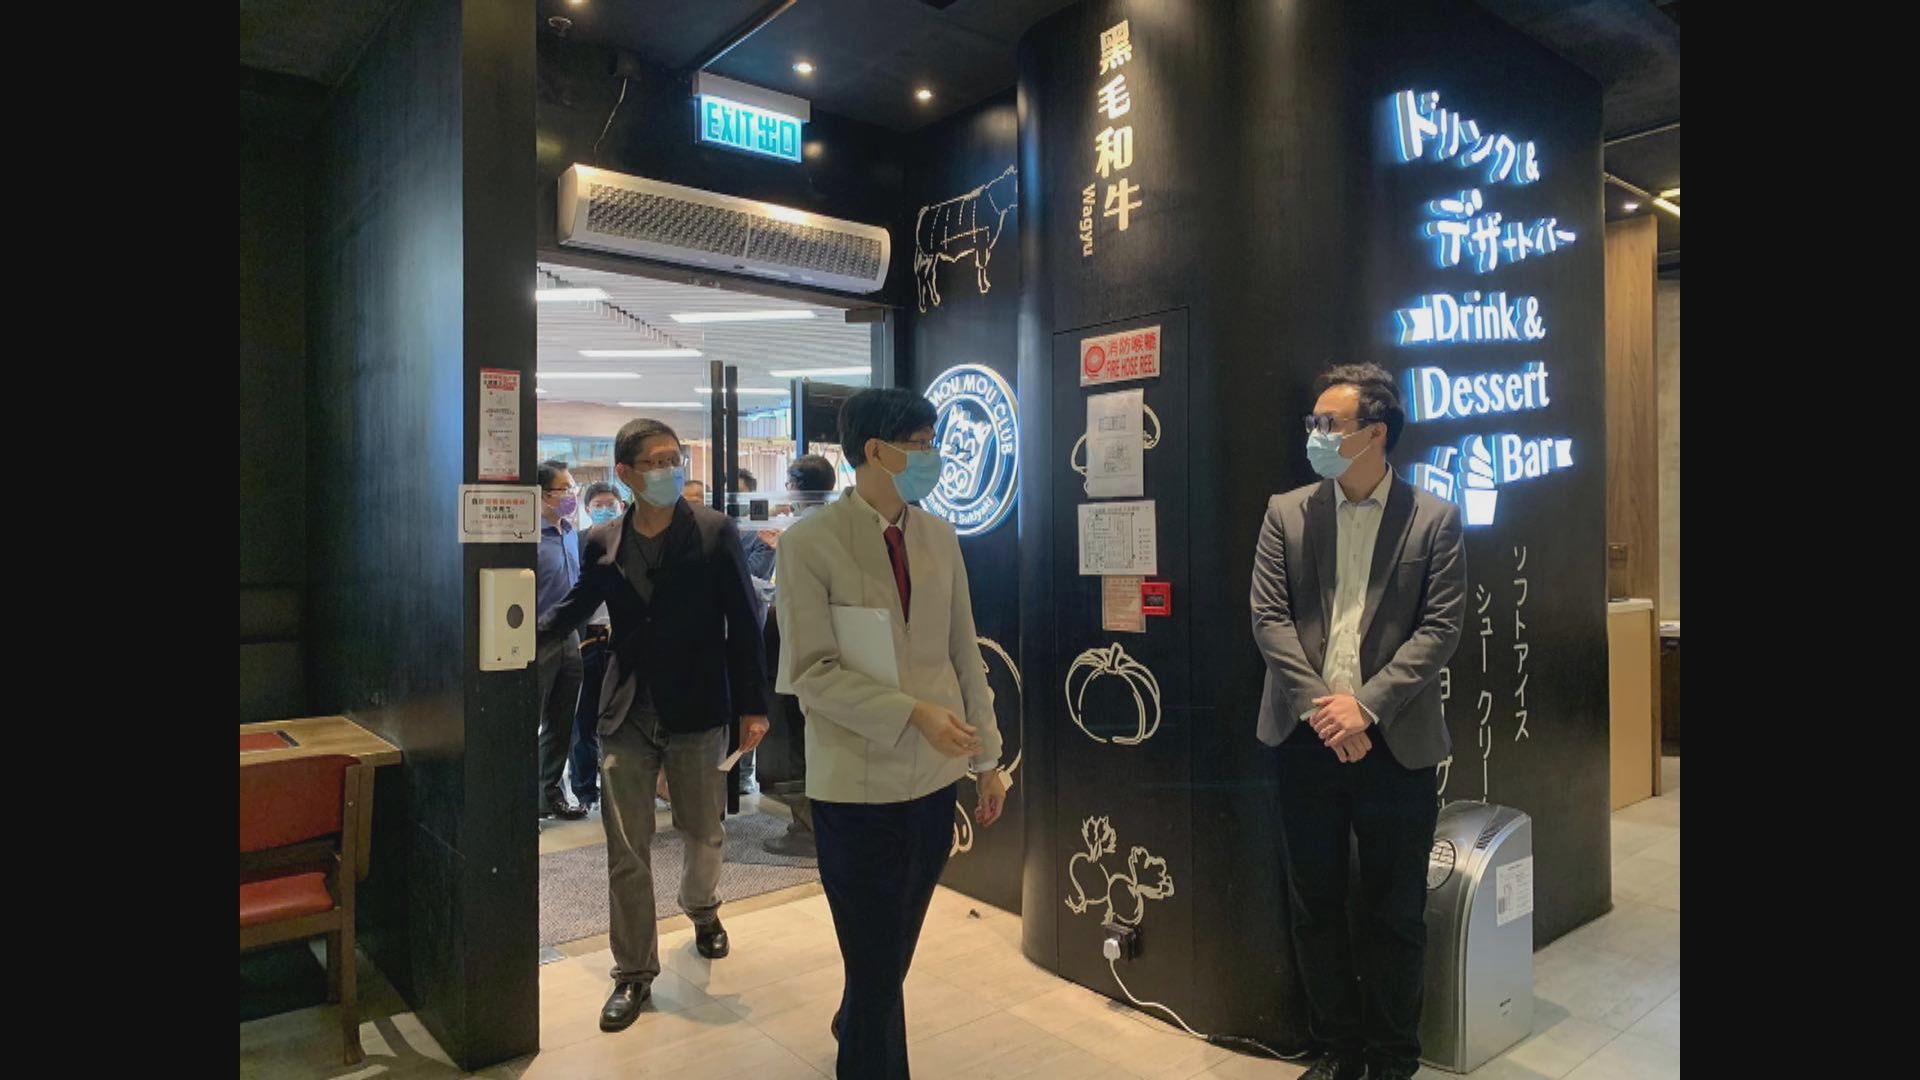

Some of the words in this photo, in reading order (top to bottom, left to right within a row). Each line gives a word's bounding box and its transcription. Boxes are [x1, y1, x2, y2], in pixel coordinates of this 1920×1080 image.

[706, 102, 753, 147] EXIT
[757, 114, 797, 157] 出口
[1095, 19, 1142, 232] 黑毛和牛
[1403, 90, 1516, 181] ドリンク
[1522, 141, 1540, 182] &
[1080, 183, 1096, 257] Wagyu
[1431, 290, 1518, 342] Drink
[1522, 295, 1546, 340] &
[1106, 359, 1120, 378] FIRE
[1121, 356, 1138, 377] HOSE
[1140, 353, 1156, 375] REEL
[1420, 361, 1550, 420] Dessert
[928, 376, 960, 407] MOU
[963, 374, 997, 403] MOU
[994, 402, 1013, 455] CLUB
[1501, 433, 1553, 483] Bar
[1513, 546, 1529, 742] ソフトアイス
